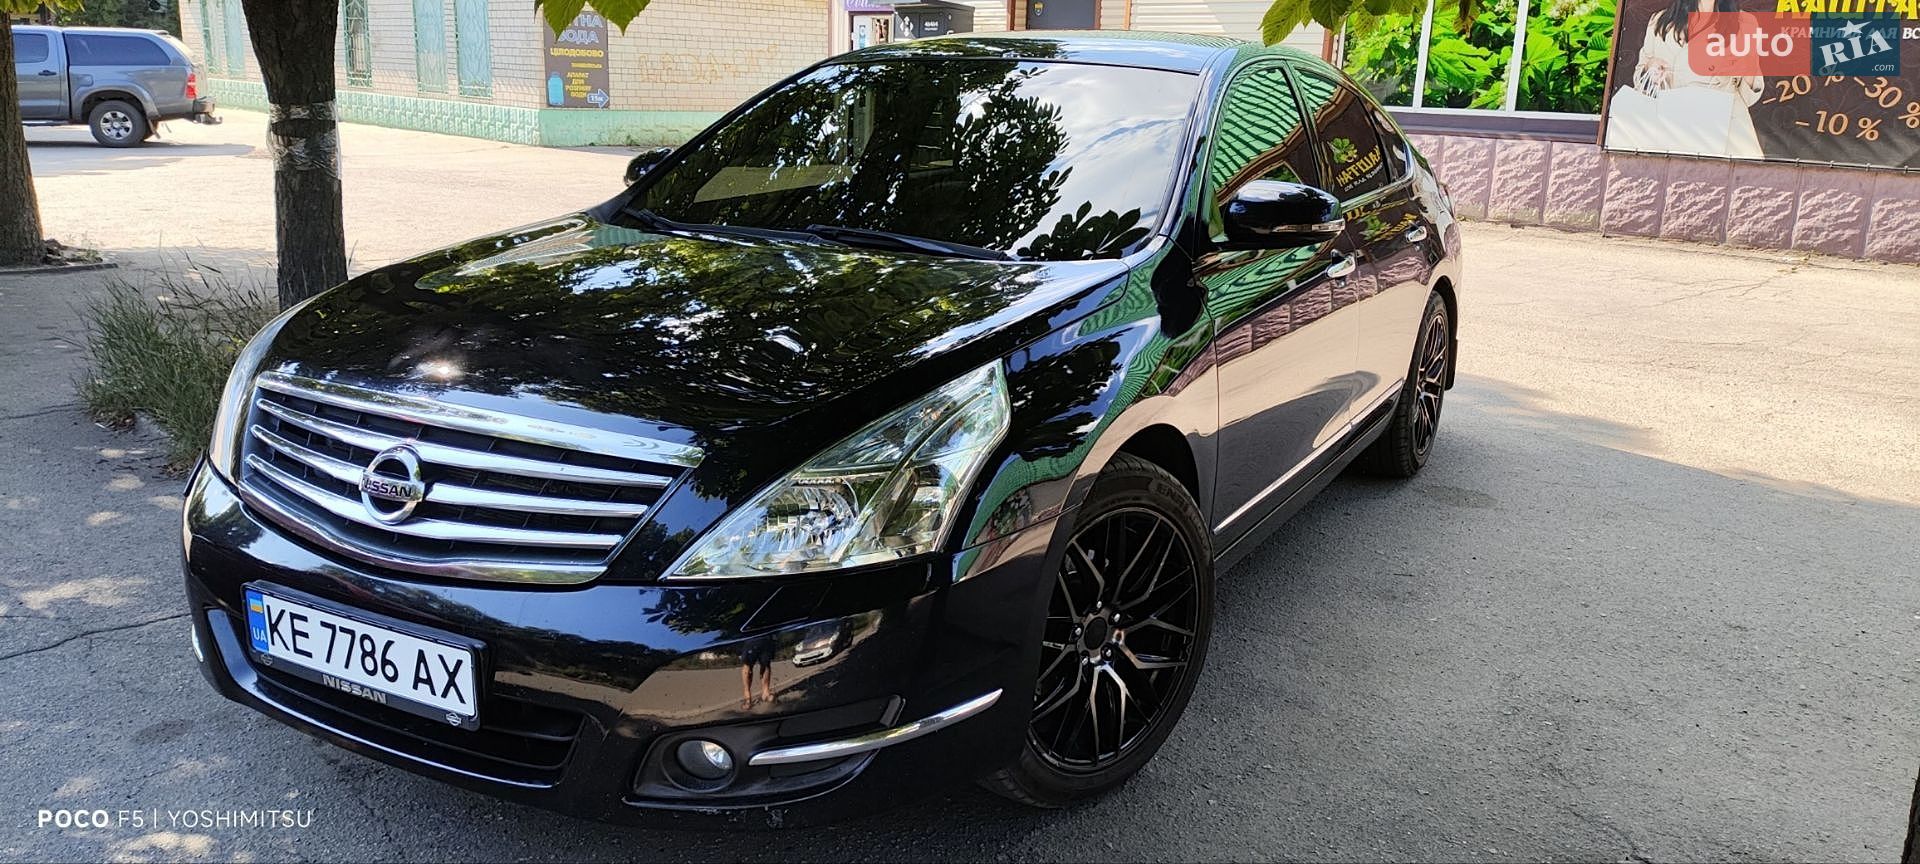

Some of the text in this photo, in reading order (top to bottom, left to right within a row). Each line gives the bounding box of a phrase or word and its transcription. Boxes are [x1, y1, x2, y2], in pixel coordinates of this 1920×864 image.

[253, 604, 466, 705] UA KE 7786 AX
[322, 674, 387, 705] NISSAN
